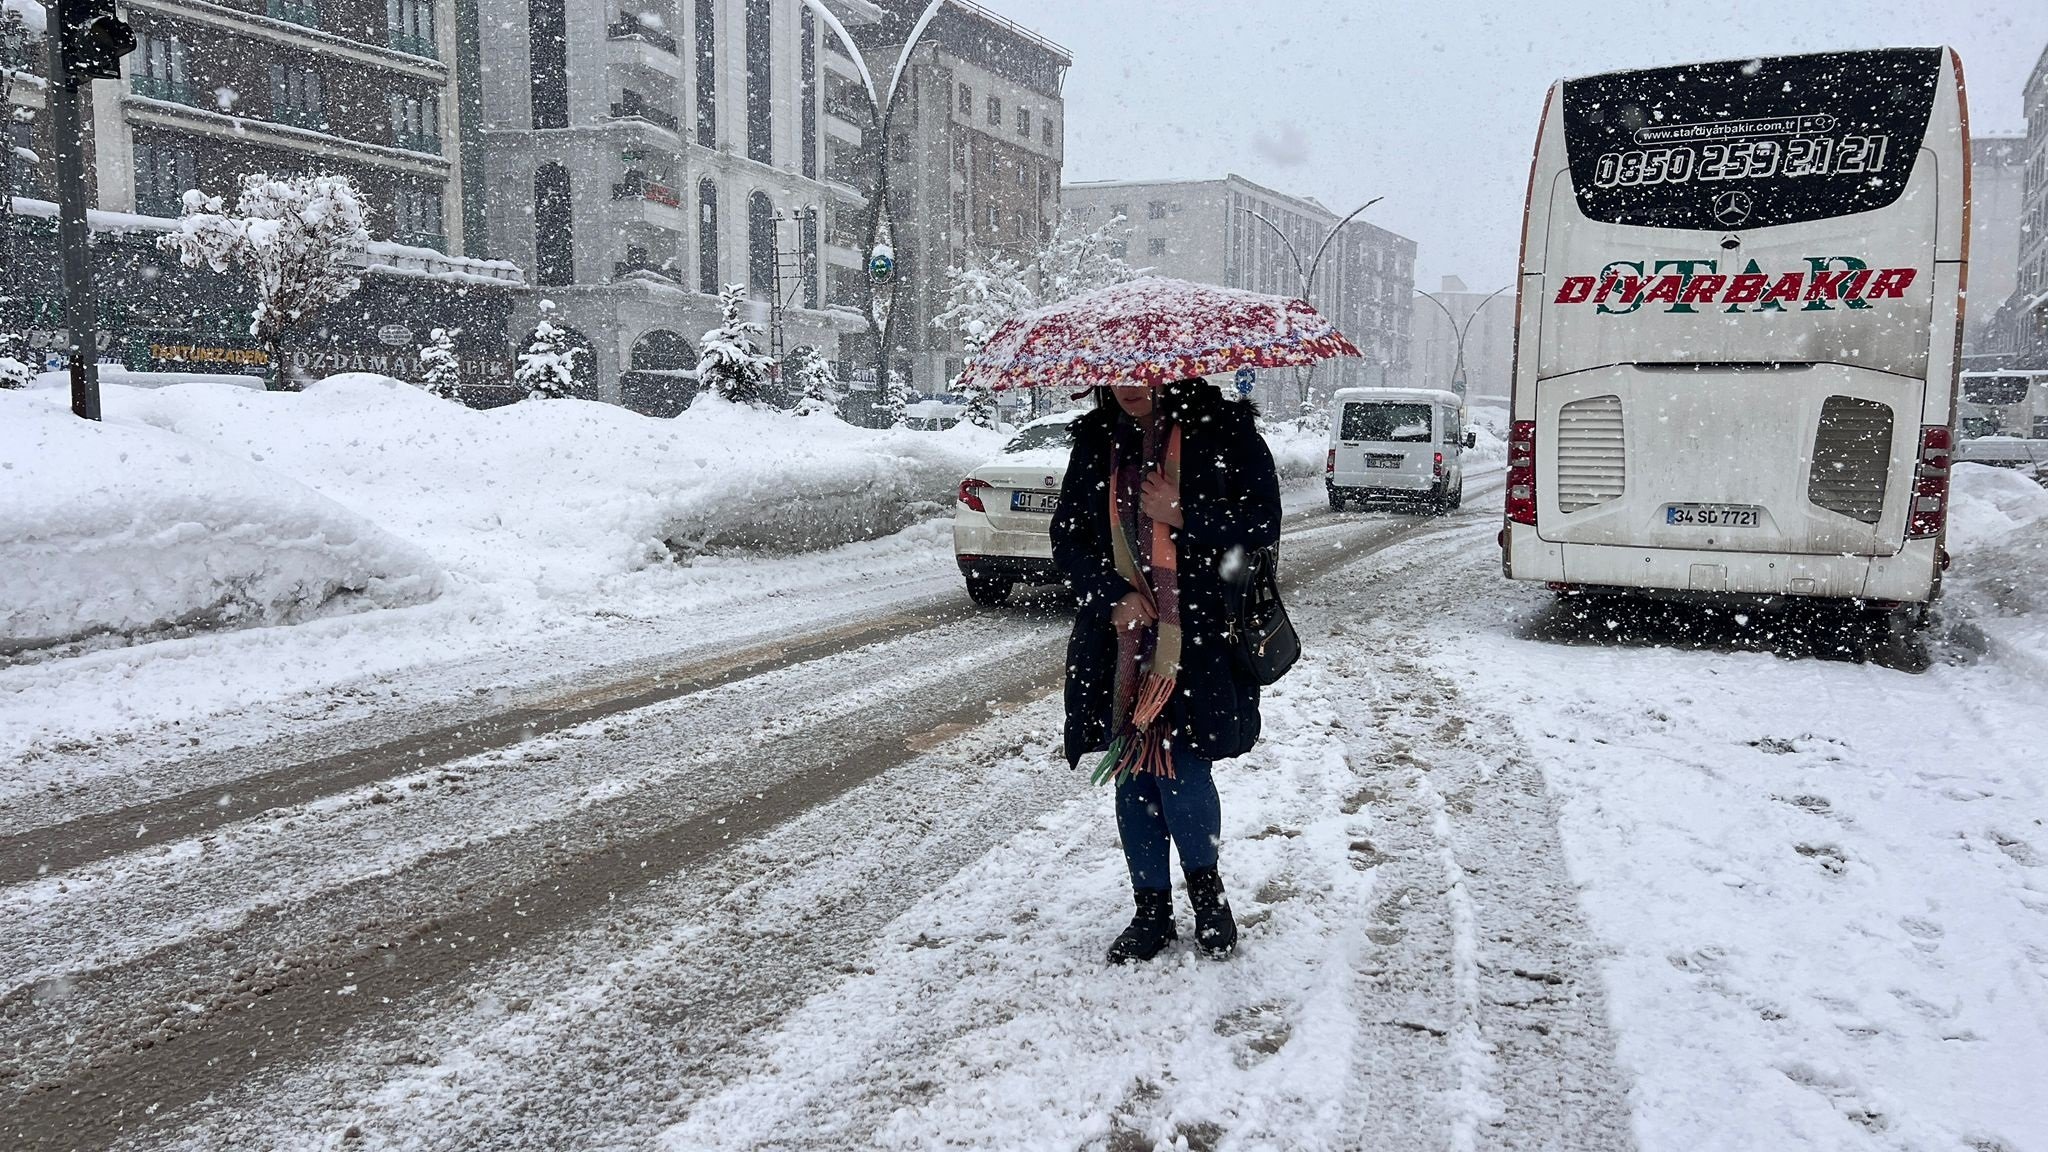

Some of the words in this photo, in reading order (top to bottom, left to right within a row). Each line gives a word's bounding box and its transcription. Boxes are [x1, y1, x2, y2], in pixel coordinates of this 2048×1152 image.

[1643, 119, 1795, 140] www.stardiyarbakir.com.tr
[1595, 147, 1694, 187] 0850
[1699, 140, 1780, 181] 259
[1784, 138, 1832, 177] 21
[1837, 135, 1888, 173] 21
[1019, 494, 1032, 506] 01
[1675, 510, 1693, 523] 34
[1698, 510, 1717, 523] SD
[1721, 511, 1757, 524] 7721
